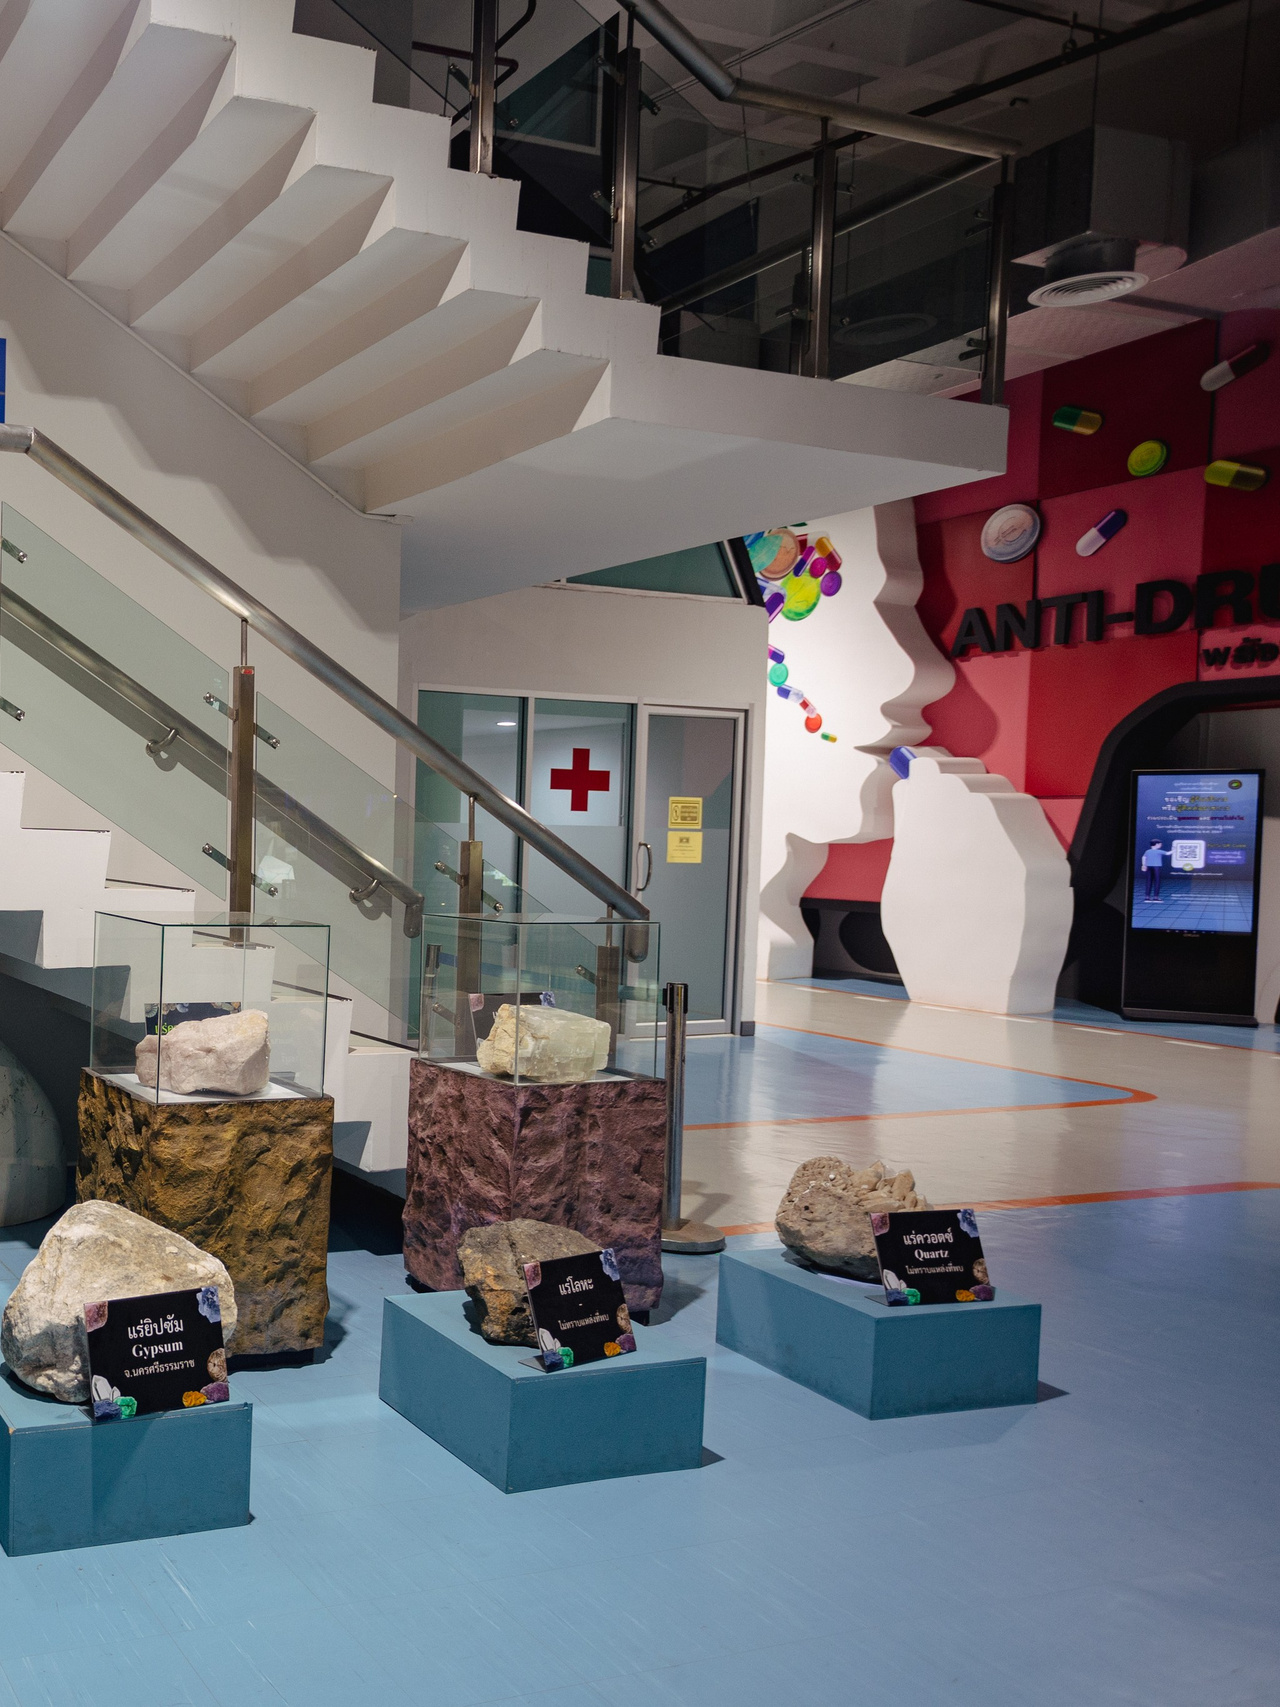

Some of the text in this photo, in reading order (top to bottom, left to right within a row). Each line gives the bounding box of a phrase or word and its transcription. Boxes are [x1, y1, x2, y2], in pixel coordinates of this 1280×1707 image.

[914, 1248, 950, 1261] Quartz
[558, 1276, 594, 1295] แร่โลหะ
[127, 1313, 184, 1340] แร่ยิปซัม
[132, 1340, 184, 1359] Gypsum
[124, 1358, 195, 1378] จ.นครศรีธรรมราช
